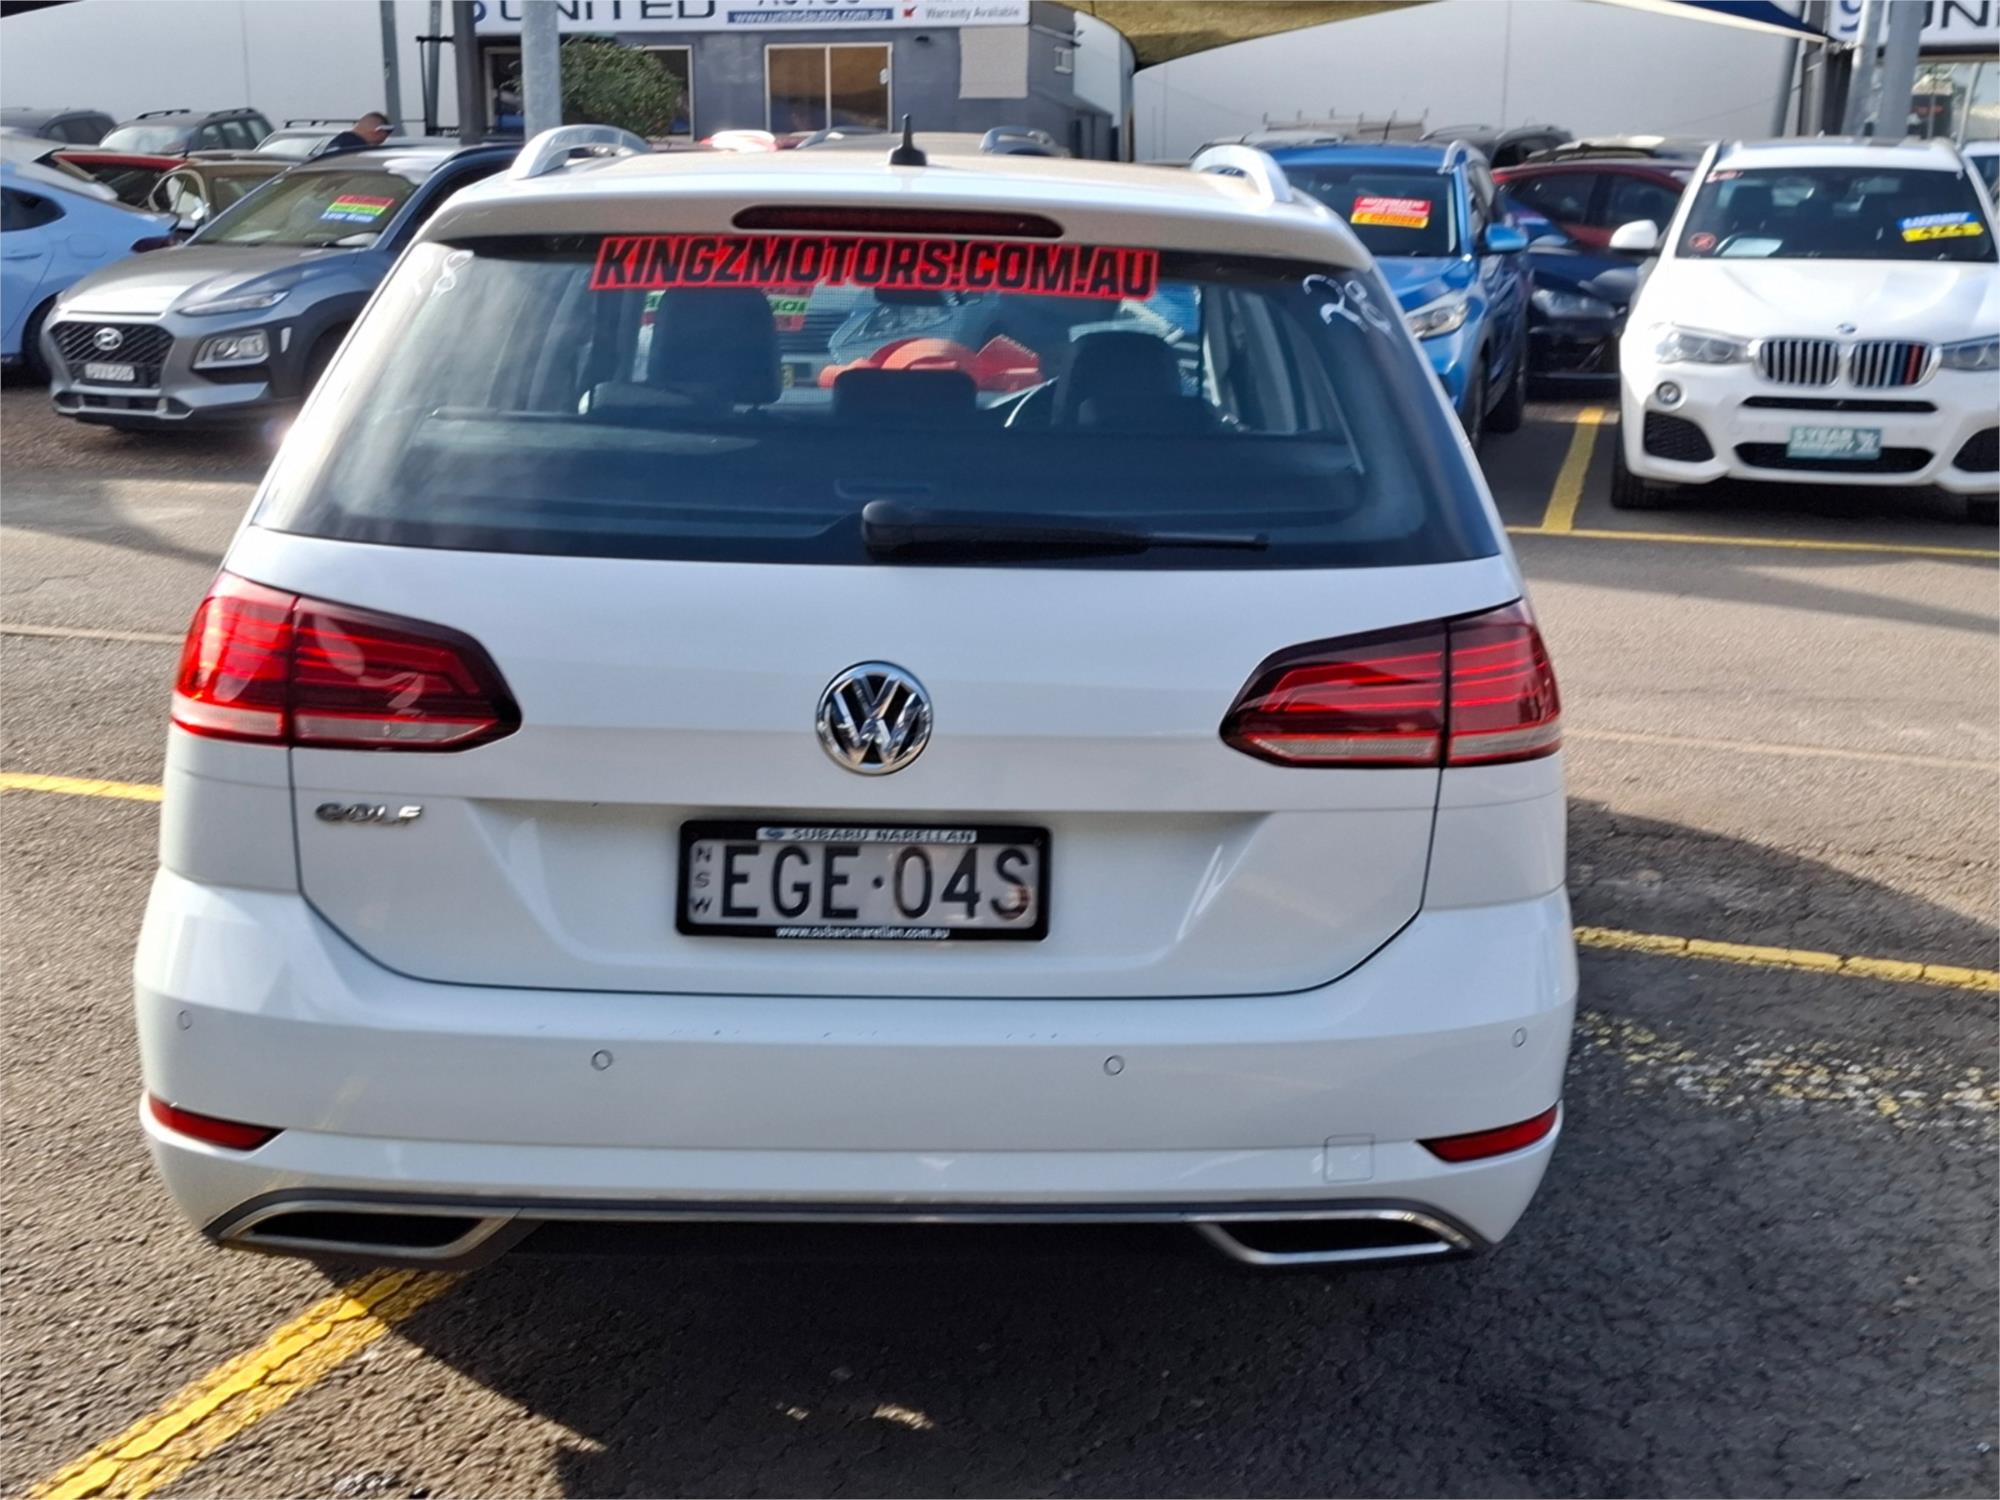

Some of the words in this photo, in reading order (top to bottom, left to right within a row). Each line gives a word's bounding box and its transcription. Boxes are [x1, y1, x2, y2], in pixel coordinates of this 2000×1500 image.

[792, 828, 869, 841] SUBARU
[876, 830, 977, 843] NARELLAN
[775, 925, 950, 940] www.subarunarellan.com.au
